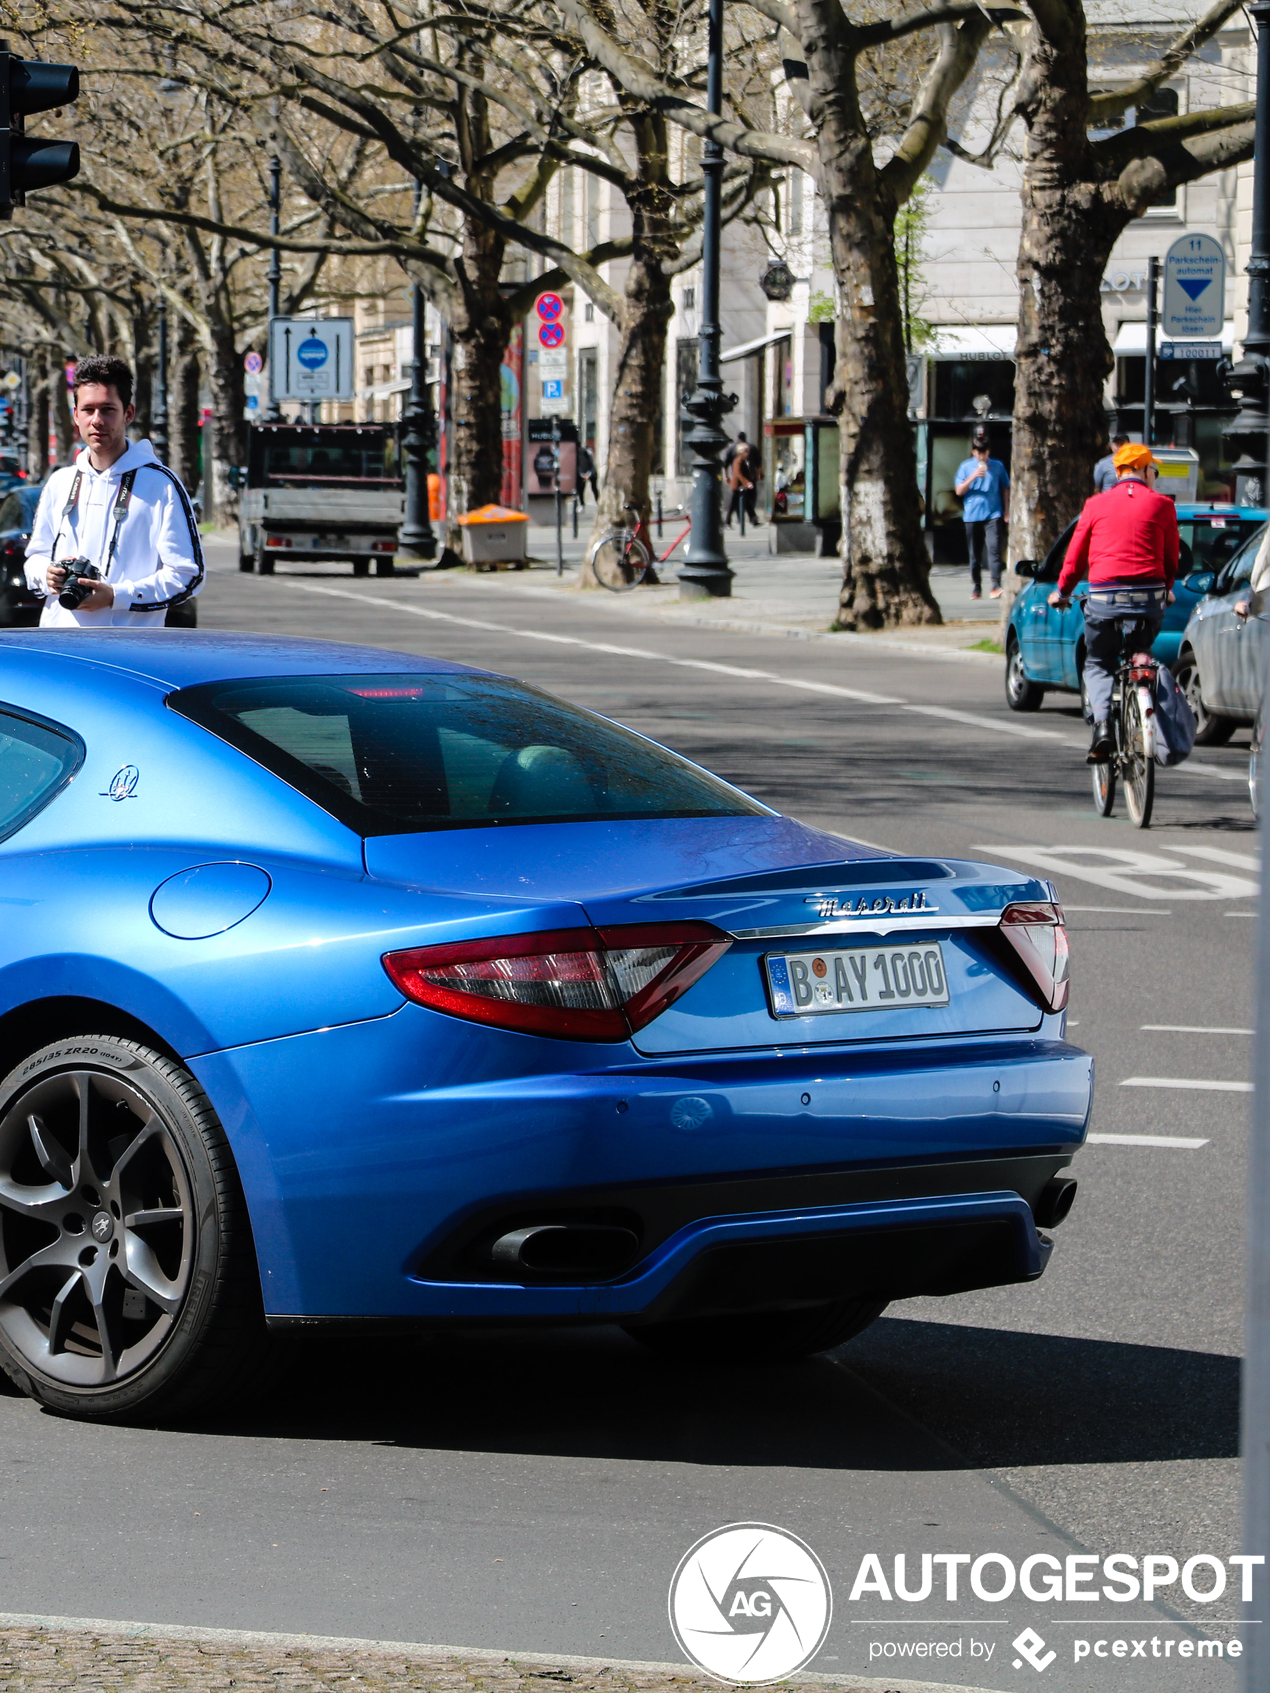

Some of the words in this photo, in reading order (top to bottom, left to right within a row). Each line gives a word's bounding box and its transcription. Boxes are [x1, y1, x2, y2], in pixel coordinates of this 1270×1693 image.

[1188, 240, 1202, 251] 11
[1169, 256, 1222, 265] Parkschein-
[1176, 267, 1213, 276] automat
[1185, 306, 1202, 314] Hier
[1171, 316, 1216, 324] Parkschein
[959, 352, 1009, 361] HUBLOT
[1180, 348, 1216, 358] 100011
[804, 892, 940, 918] Maserati
[789, 960, 813, 1007] B
[835, 955, 869, 1003] AY
[873, 950, 945, 1000] 1000
[22, 1050, 62, 1076] 285/35
[64, 1047, 99, 1056] ZR20
